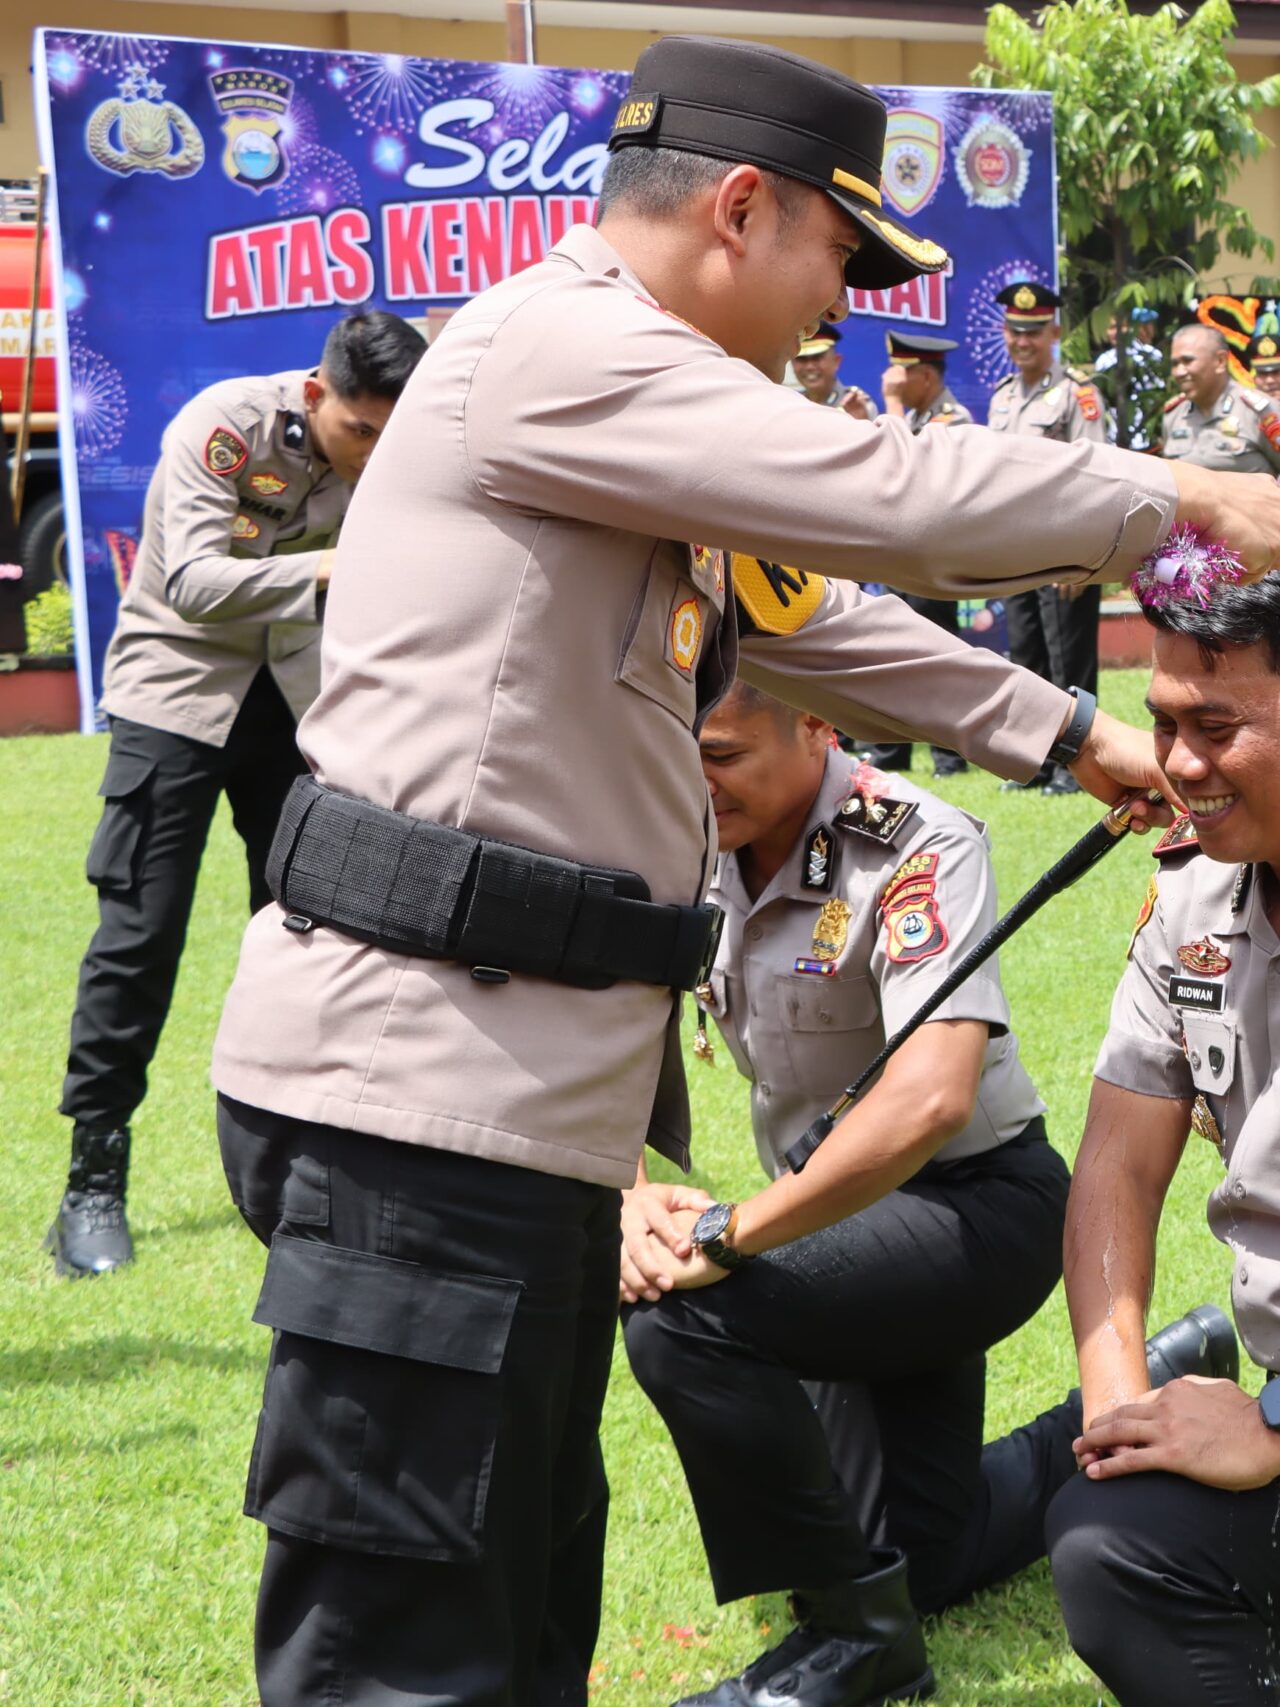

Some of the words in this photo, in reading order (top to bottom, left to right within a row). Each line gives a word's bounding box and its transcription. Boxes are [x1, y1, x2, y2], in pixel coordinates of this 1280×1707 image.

[405, 97, 612, 192] Sela
[616, 102, 653, 128] LRES
[207, 207, 374, 318] ATAS
[383, 196, 600, 299] KENAI
[1177, 985, 1213, 1001] RIDWAN
